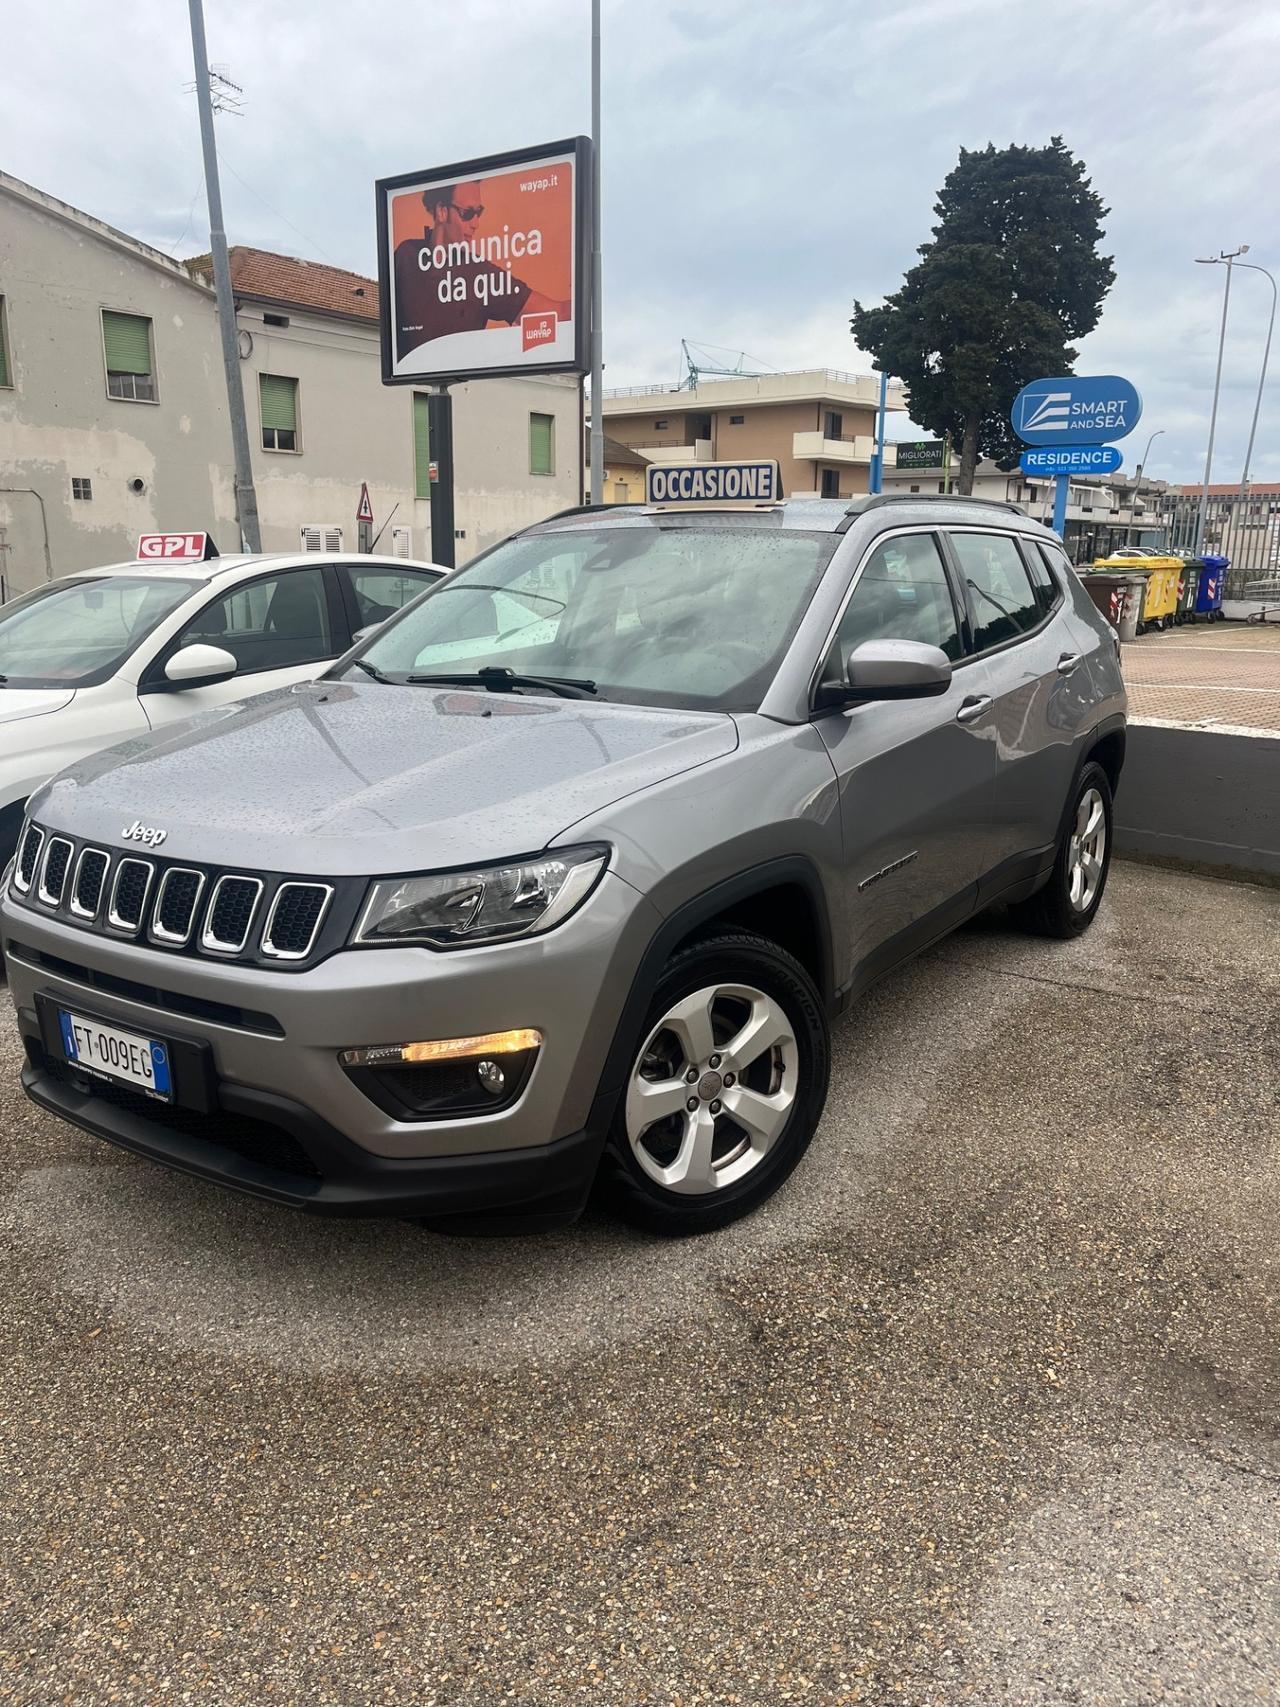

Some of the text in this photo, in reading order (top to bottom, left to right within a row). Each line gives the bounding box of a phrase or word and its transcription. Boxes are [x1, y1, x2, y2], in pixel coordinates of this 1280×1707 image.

[519, 174, 558, 193] wayap.it
[418, 224, 543, 272] comunica
[437, 261, 520, 306] da qui.
[526, 327, 552, 340] WAYAP
[1071, 400, 1129, 416] SMART
[1070, 415, 1127, 430] AND SEA
[898, 450, 942, 460] MIGLIORATI
[1027, 451, 1113, 465] RESIDENCE
[652, 468, 771, 500] OCCASIONE
[142, 537, 200, 556] GPL
[121, 820, 168, 848] Jeep
